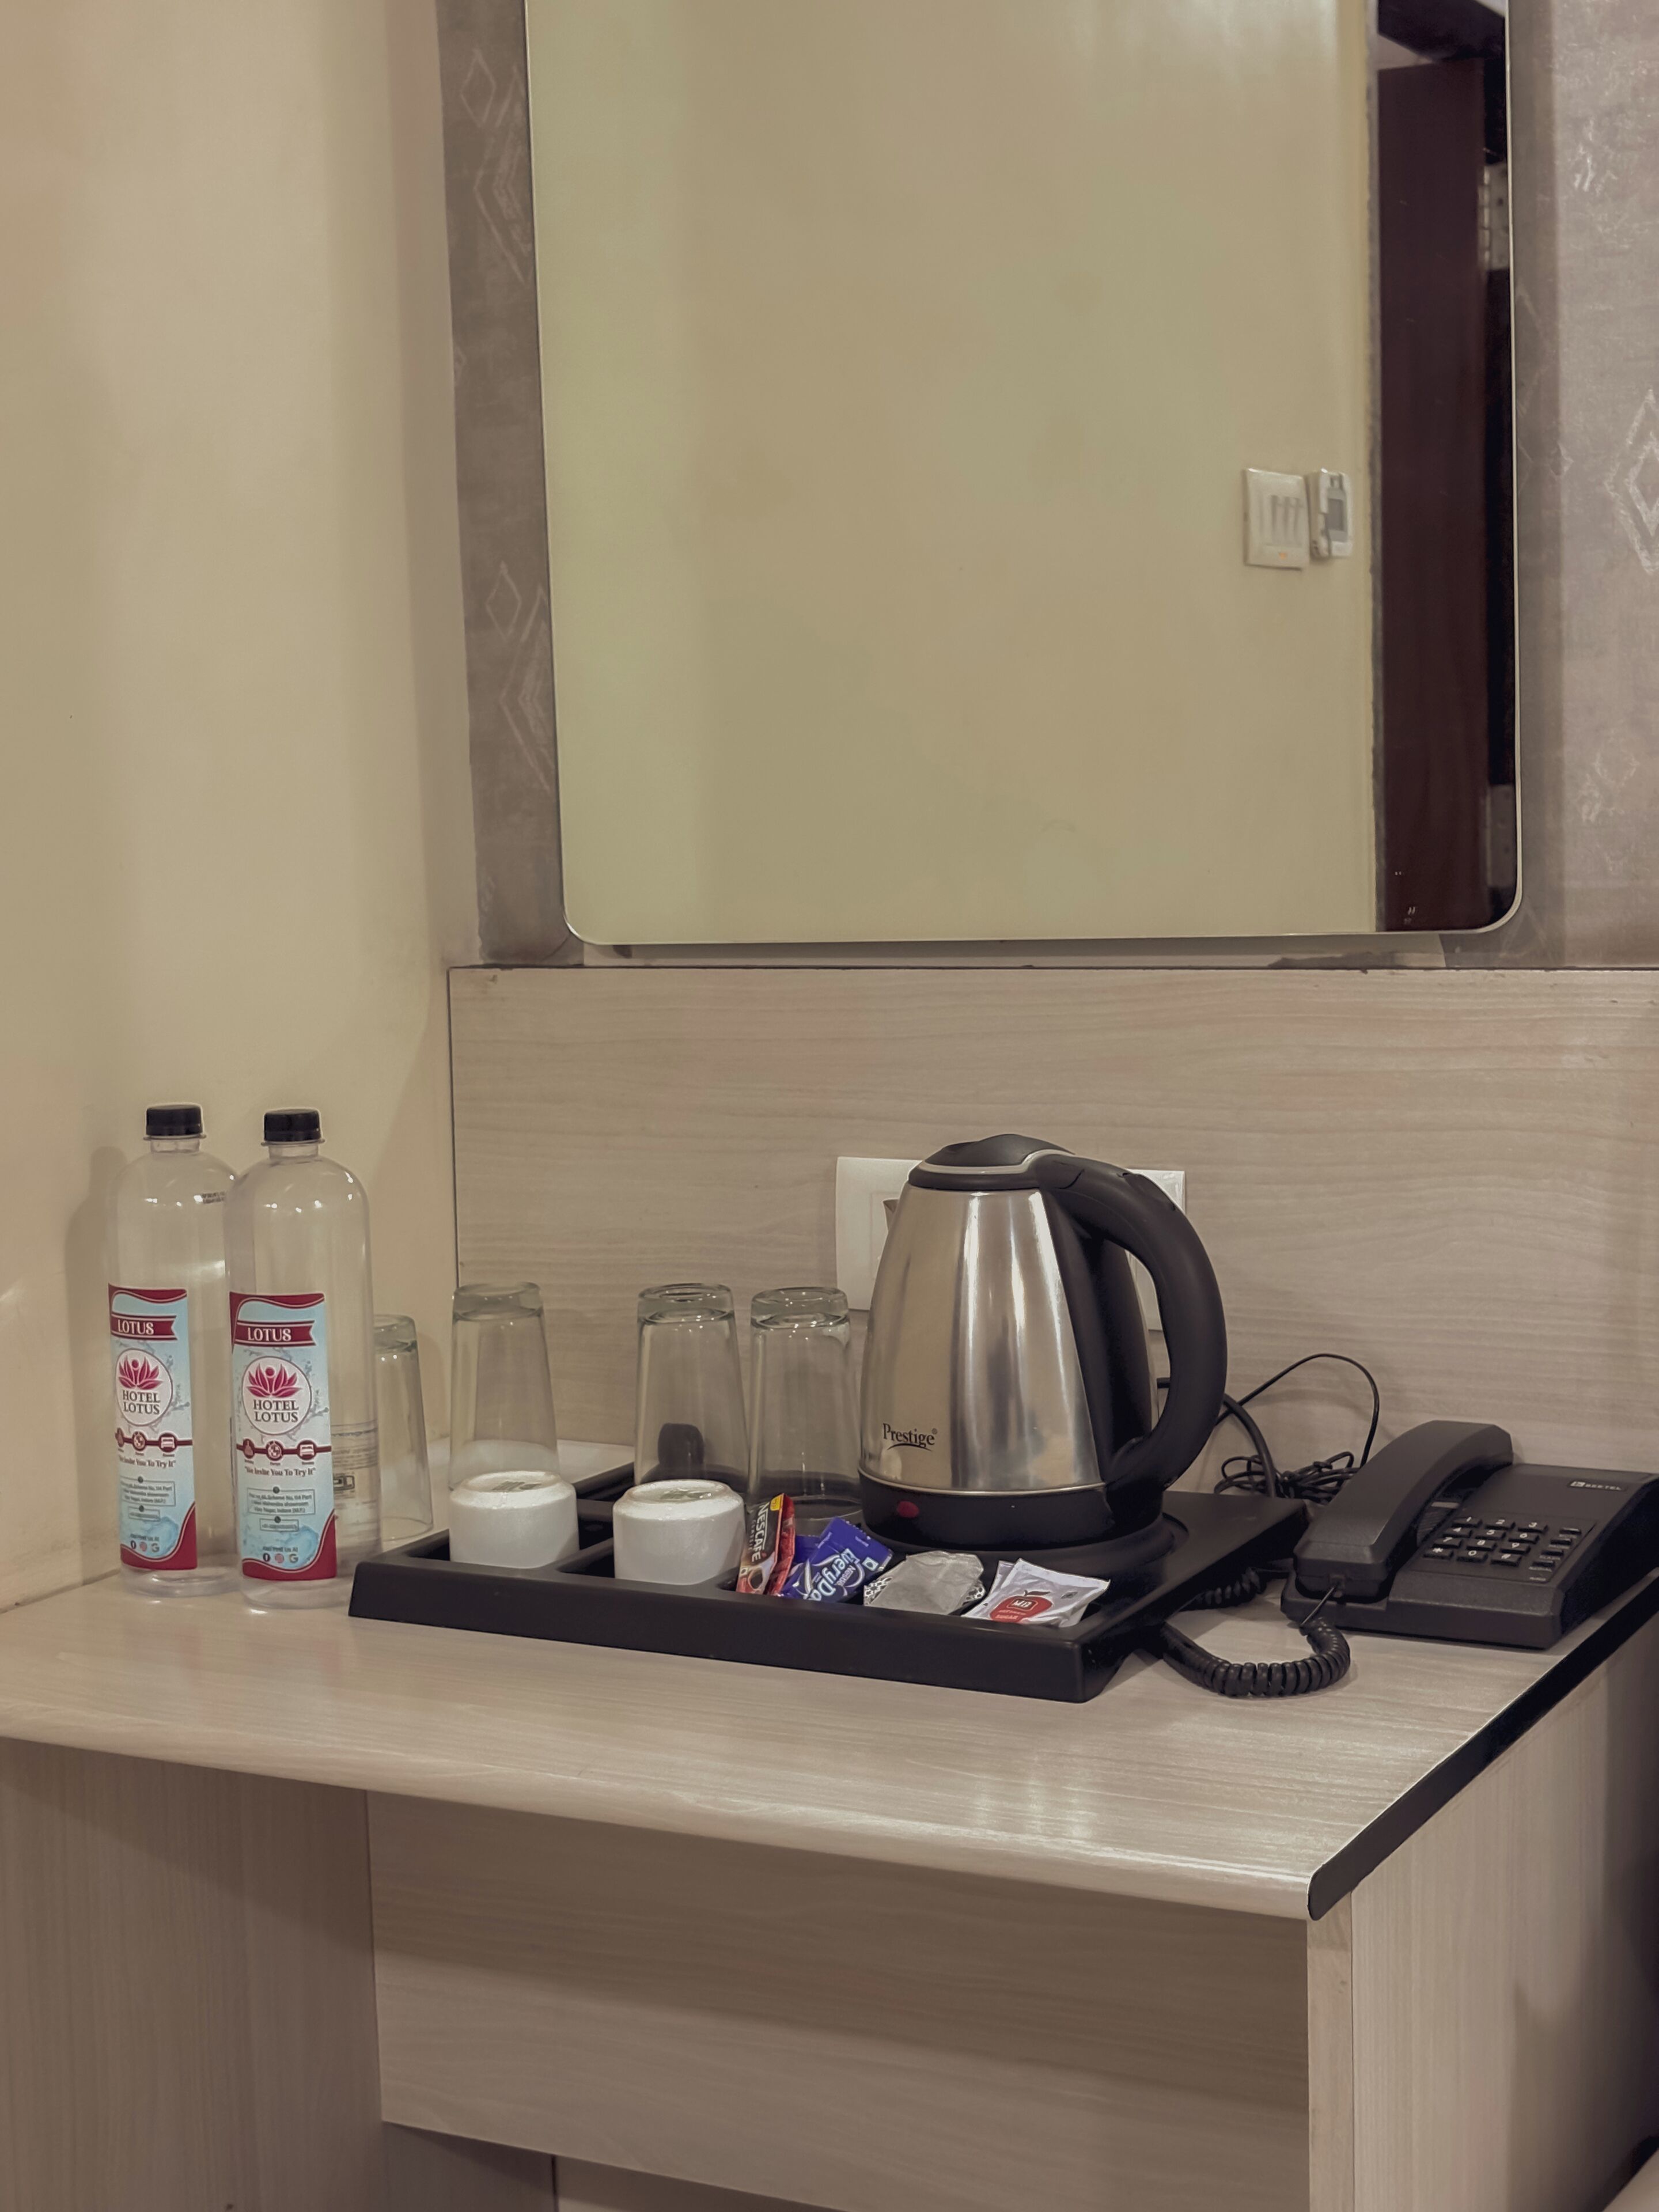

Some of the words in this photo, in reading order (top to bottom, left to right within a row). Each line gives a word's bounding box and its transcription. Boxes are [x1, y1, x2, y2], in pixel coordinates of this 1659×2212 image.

[118, 1319, 154, 1335] LOTUS
[248, 1327, 291, 1342] LOTUS
[123, 1389, 161, 1403] HOTEL
[123, 1402, 160, 1414] LOTUS
[253, 1399, 299, 1411] HOTEL
[255, 1411, 298, 1422] LOTUS
[882, 1423, 935, 1448] Prestige
[156, 1460, 166, 1468] Try
[294, 1468, 306, 1477] Try
